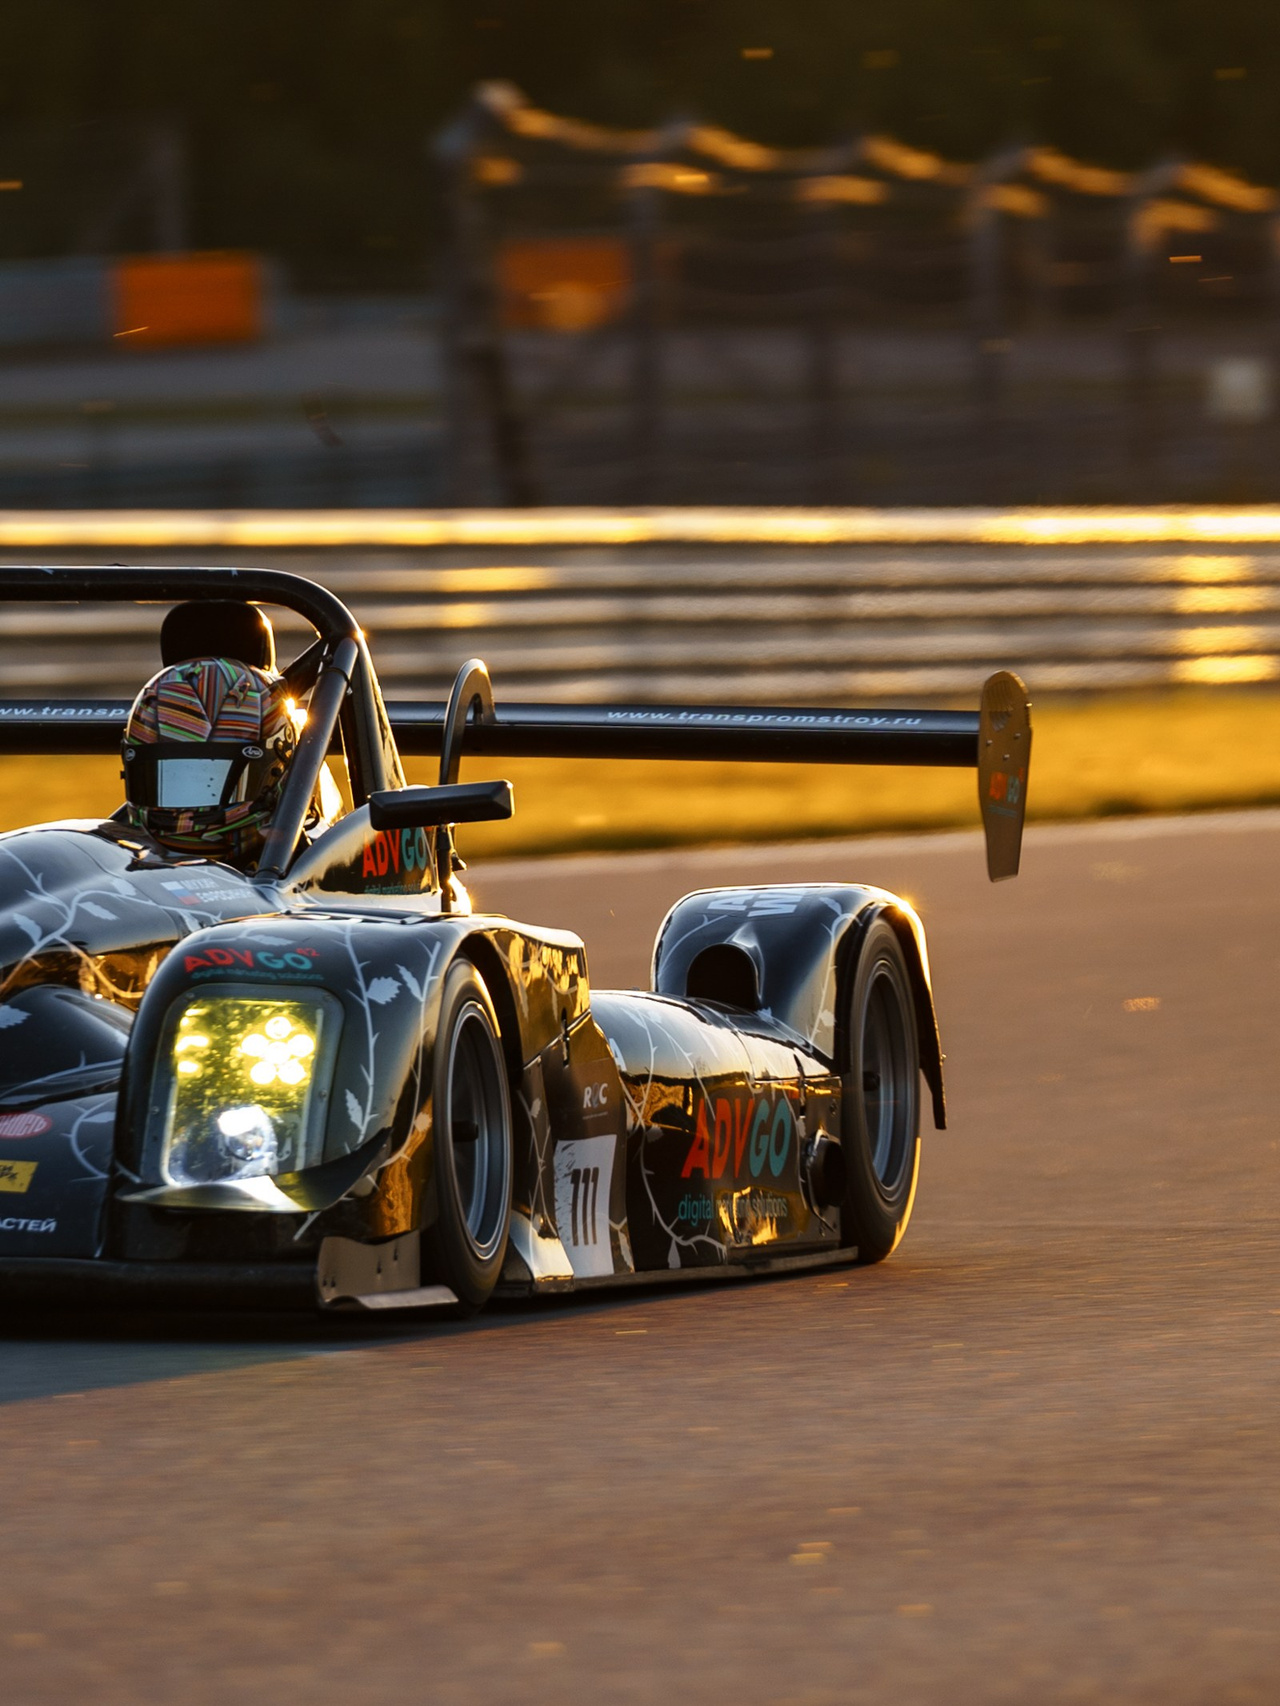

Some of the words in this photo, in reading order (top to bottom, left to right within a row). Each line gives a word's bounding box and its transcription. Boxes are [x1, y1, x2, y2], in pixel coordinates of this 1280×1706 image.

[607, 709, 922, 726] www.transpromstroy.ru
[184, 947, 313, 973] ADVGO
[680, 1097, 792, 1179] ADVGO
[570, 1166, 600, 1246] 111
[678, 1192, 714, 1227] digital
